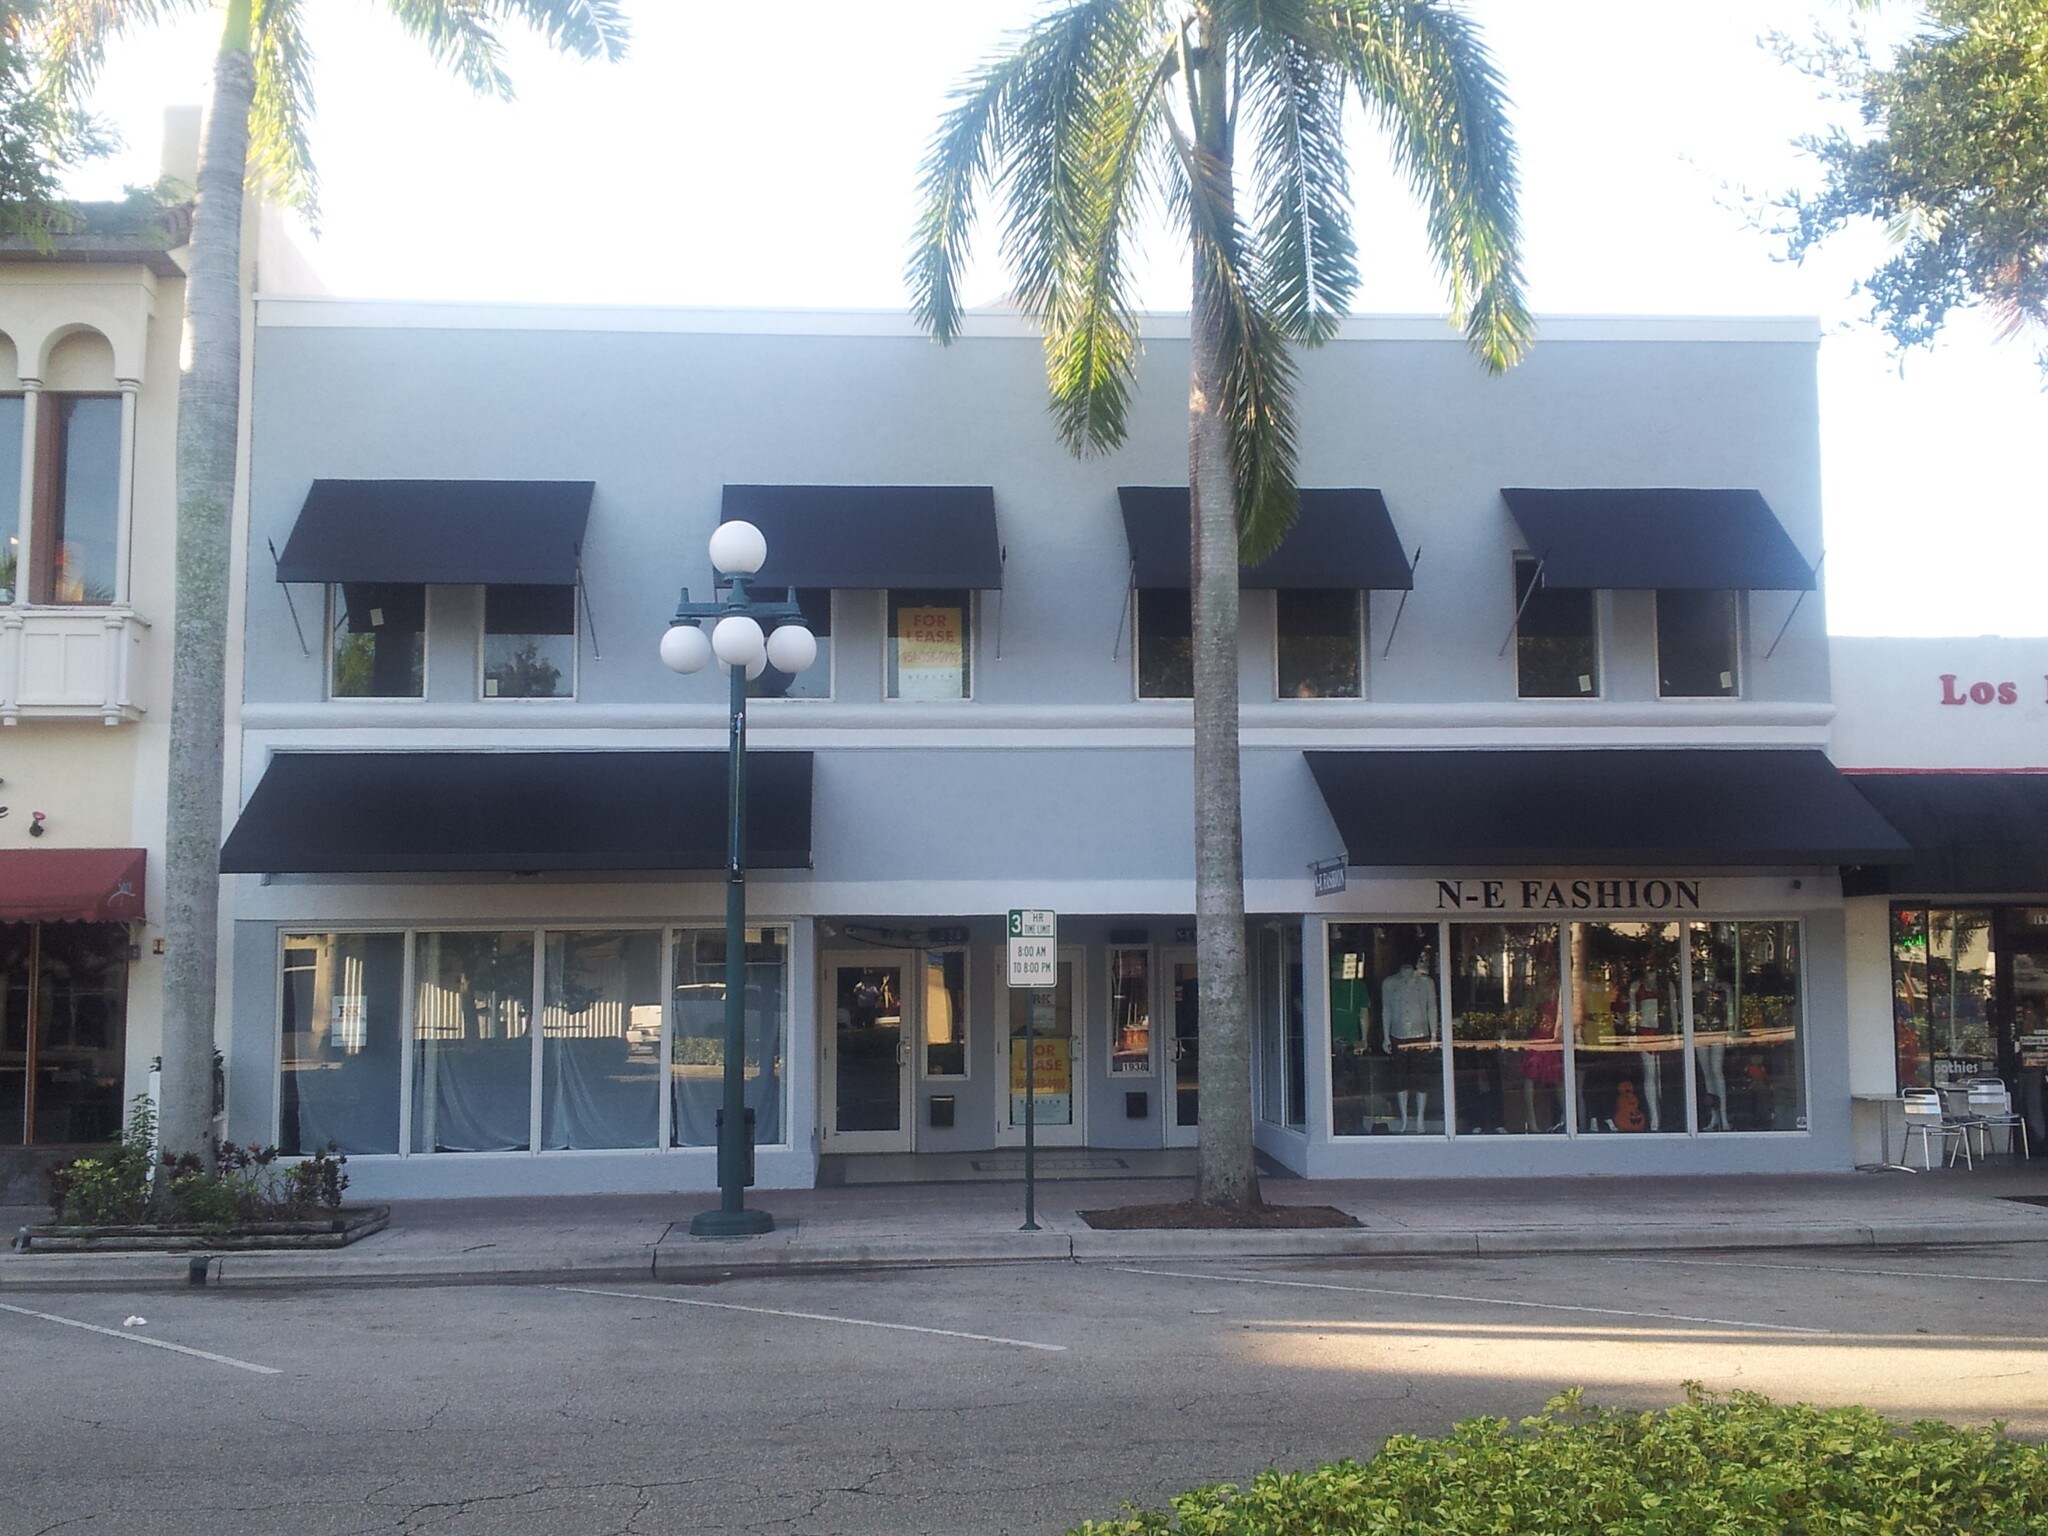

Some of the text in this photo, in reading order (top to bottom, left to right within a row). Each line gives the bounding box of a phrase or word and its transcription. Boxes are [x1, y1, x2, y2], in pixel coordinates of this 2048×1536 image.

[913, 615, 946, 627] FOR
[905, 630, 954, 643] LEASE
[1939, 674, 2018, 705] Los
[1436, 880, 1701, 909] N-E FASHION
[1011, 913, 1044, 933] 3 HR
[2034, 914, 2048, 925] 19
[1024, 924, 1051, 934] TIME LIMIT
[1017, 946, 1047, 957] 8:00 AM
[1013, 962, 1052, 973] TO 8:00 PM
[1031, 1045, 1056, 1056] OR
[1017, 1059, 1062, 1071] LASE
